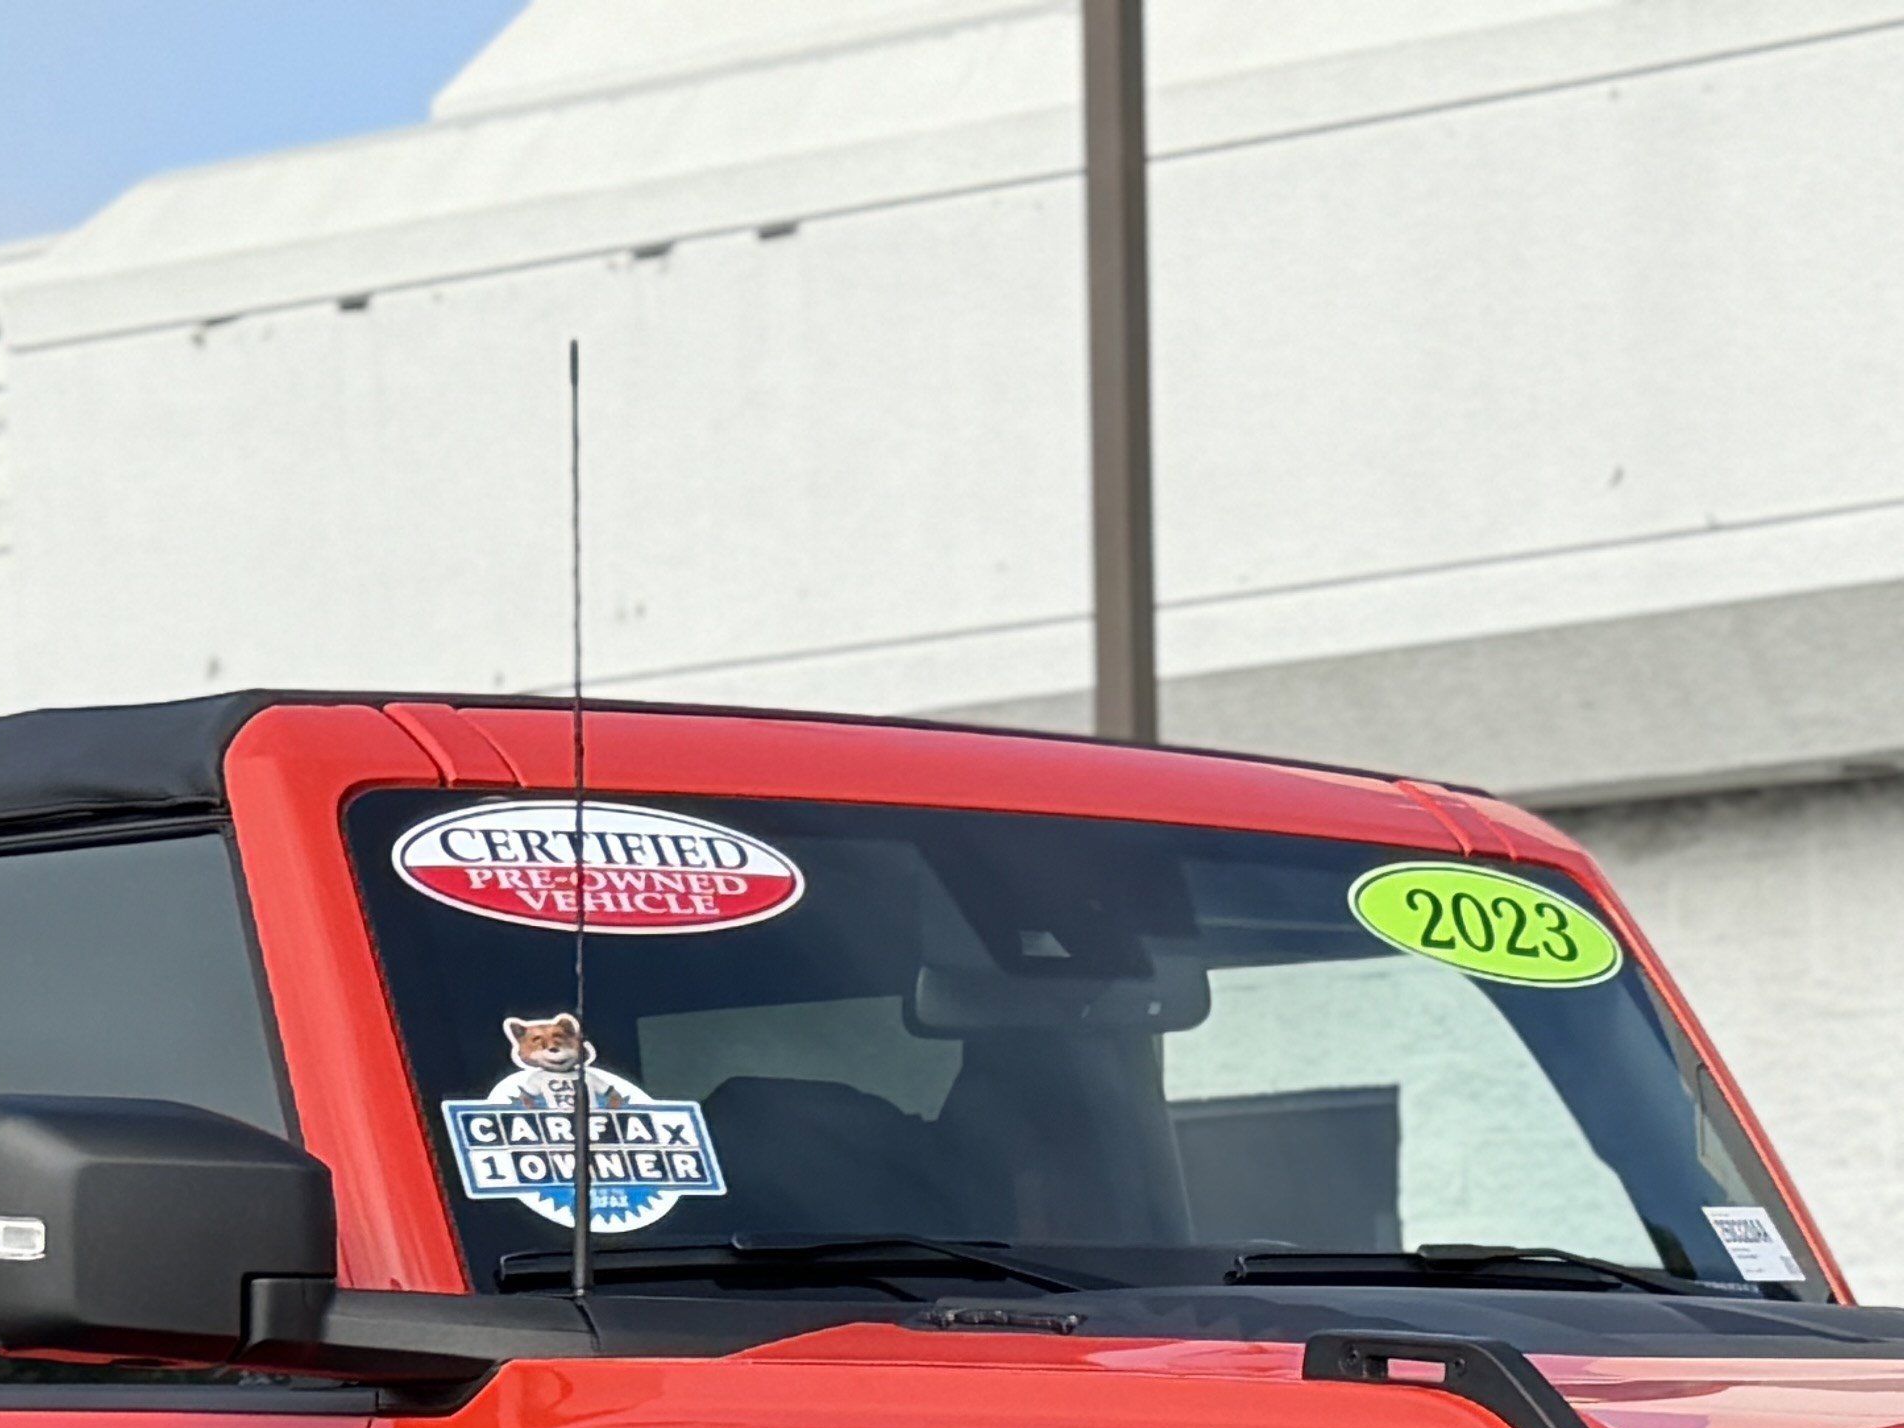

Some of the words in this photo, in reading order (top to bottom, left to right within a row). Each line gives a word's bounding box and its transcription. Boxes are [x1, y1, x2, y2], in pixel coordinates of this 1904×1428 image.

[439, 827, 749, 871] CERTIFIED
[463, 867, 749, 897] PRE-OWNED
[514, 888, 721, 916] VEHICLE
[1405, 888, 1580, 962] 2023
[469, 1115, 690, 1146] CARFAX
[481, 1155, 508, 1181] 1
[518, 1150, 702, 1181] OWNER
